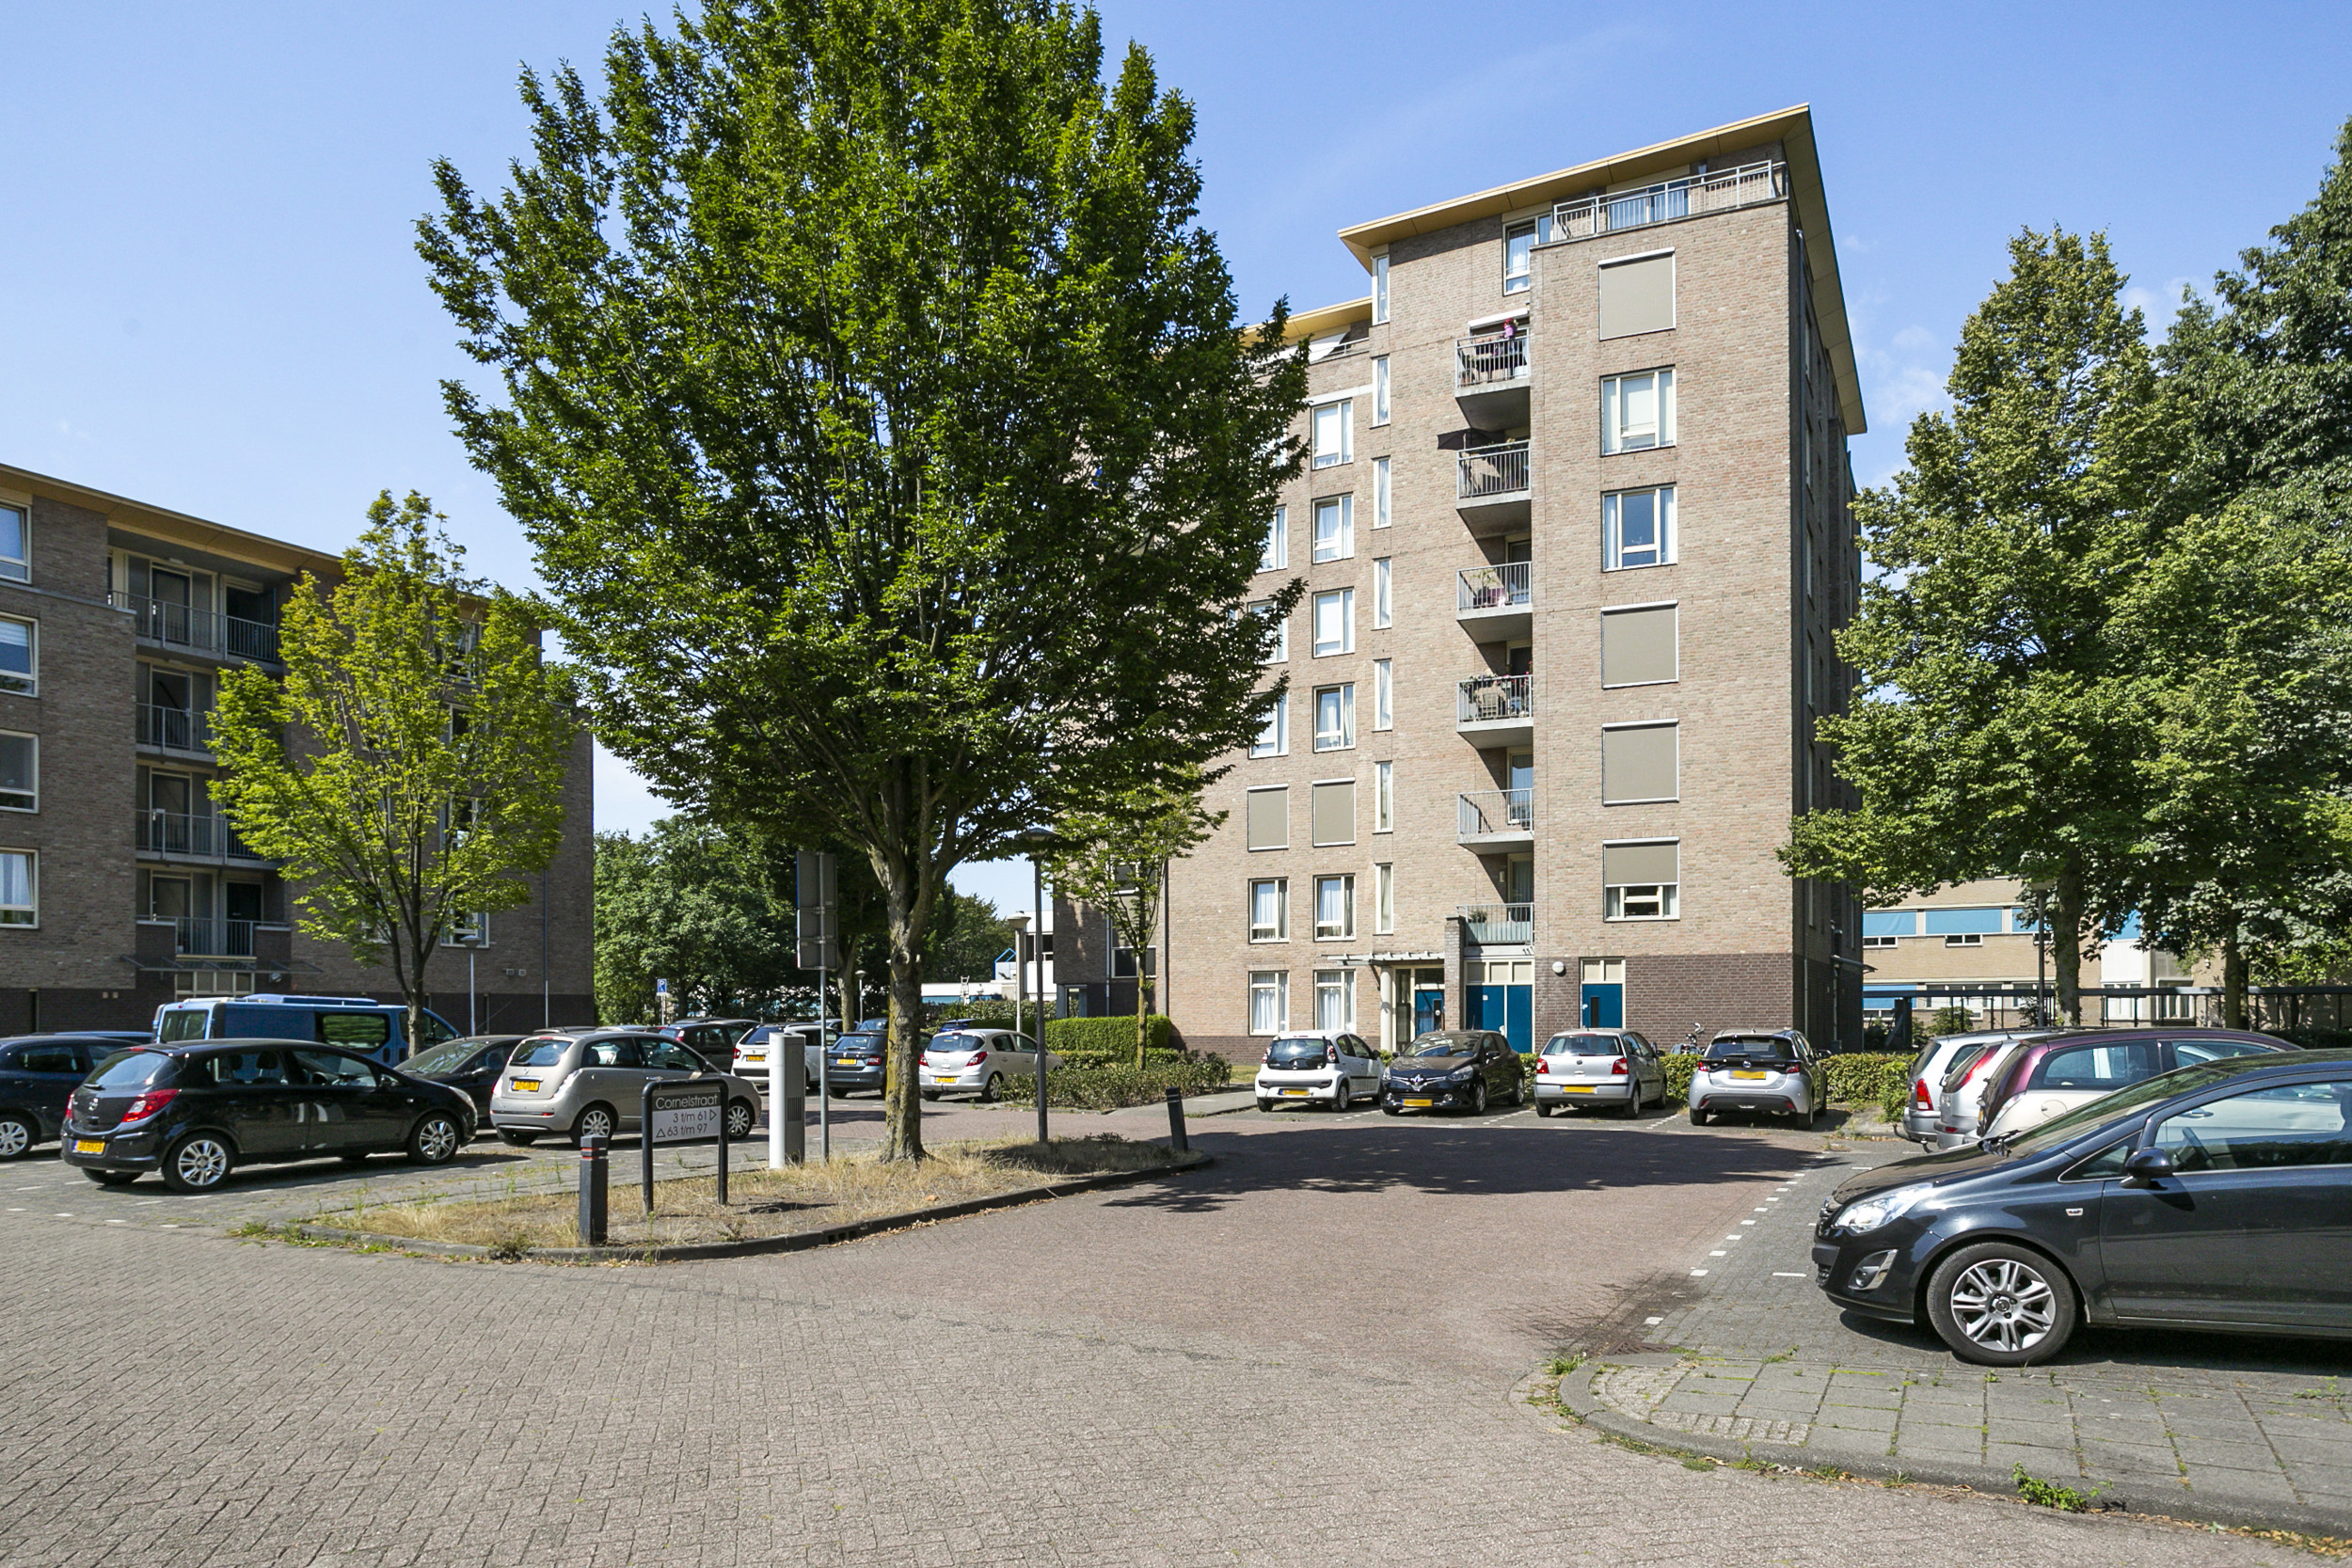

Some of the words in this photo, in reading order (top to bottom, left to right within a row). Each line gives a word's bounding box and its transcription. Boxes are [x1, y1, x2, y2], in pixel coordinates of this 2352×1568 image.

[655, 1094, 718, 1109] Cornelstraat
[673, 1113, 678, 1123] 3
[681, 1113, 695, 1123] t/m
[697, 1111, 707, 1121] 61
[667, 1126, 678, 1136] 63
[680, 1126, 695, 1135] t/m
[697, 1124, 707, 1133] 97
